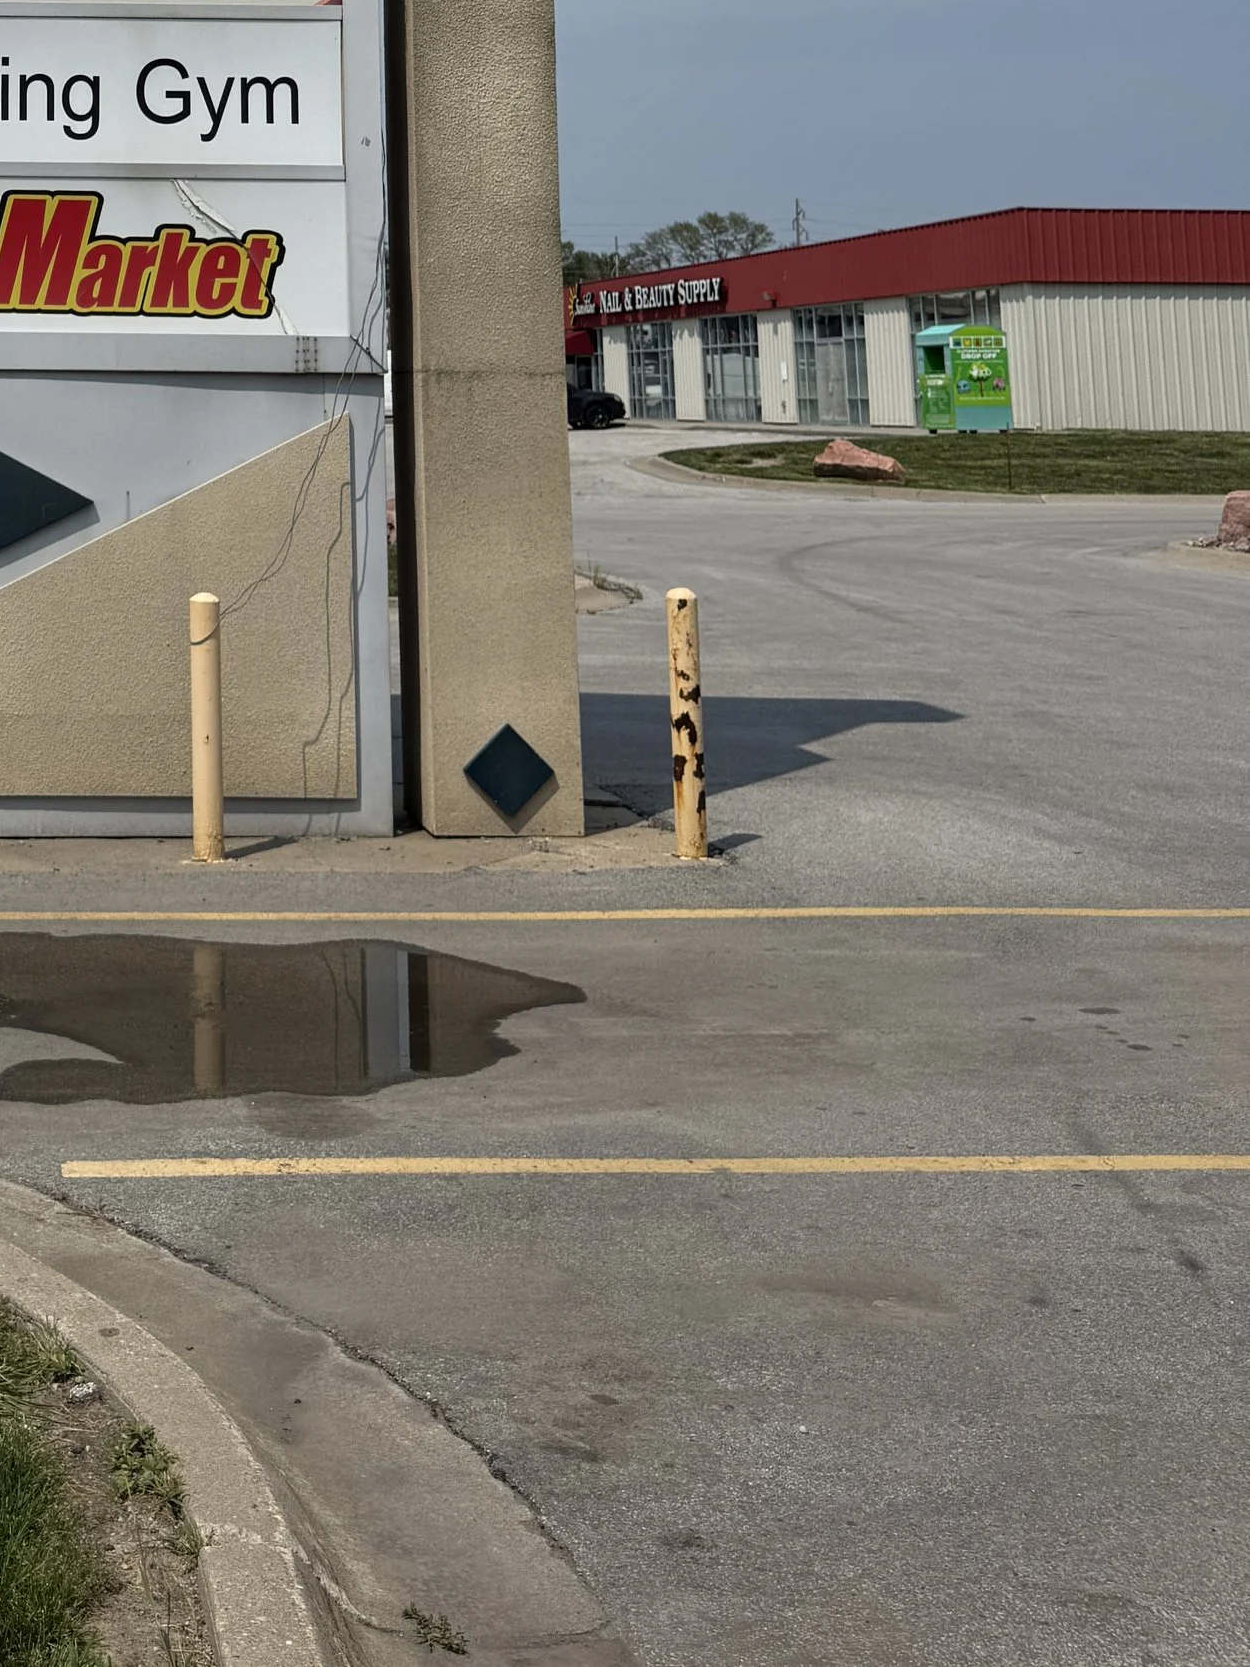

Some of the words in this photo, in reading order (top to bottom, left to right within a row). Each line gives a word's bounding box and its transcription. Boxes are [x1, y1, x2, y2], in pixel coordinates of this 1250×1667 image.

[136, 58, 299, 142] Gym
[600, 290, 622, 314] NAIL
[624, 287, 632, 311] &
[635, 284, 675, 309] BEAUTY
[678, 277, 721, 304] SUPPLY
